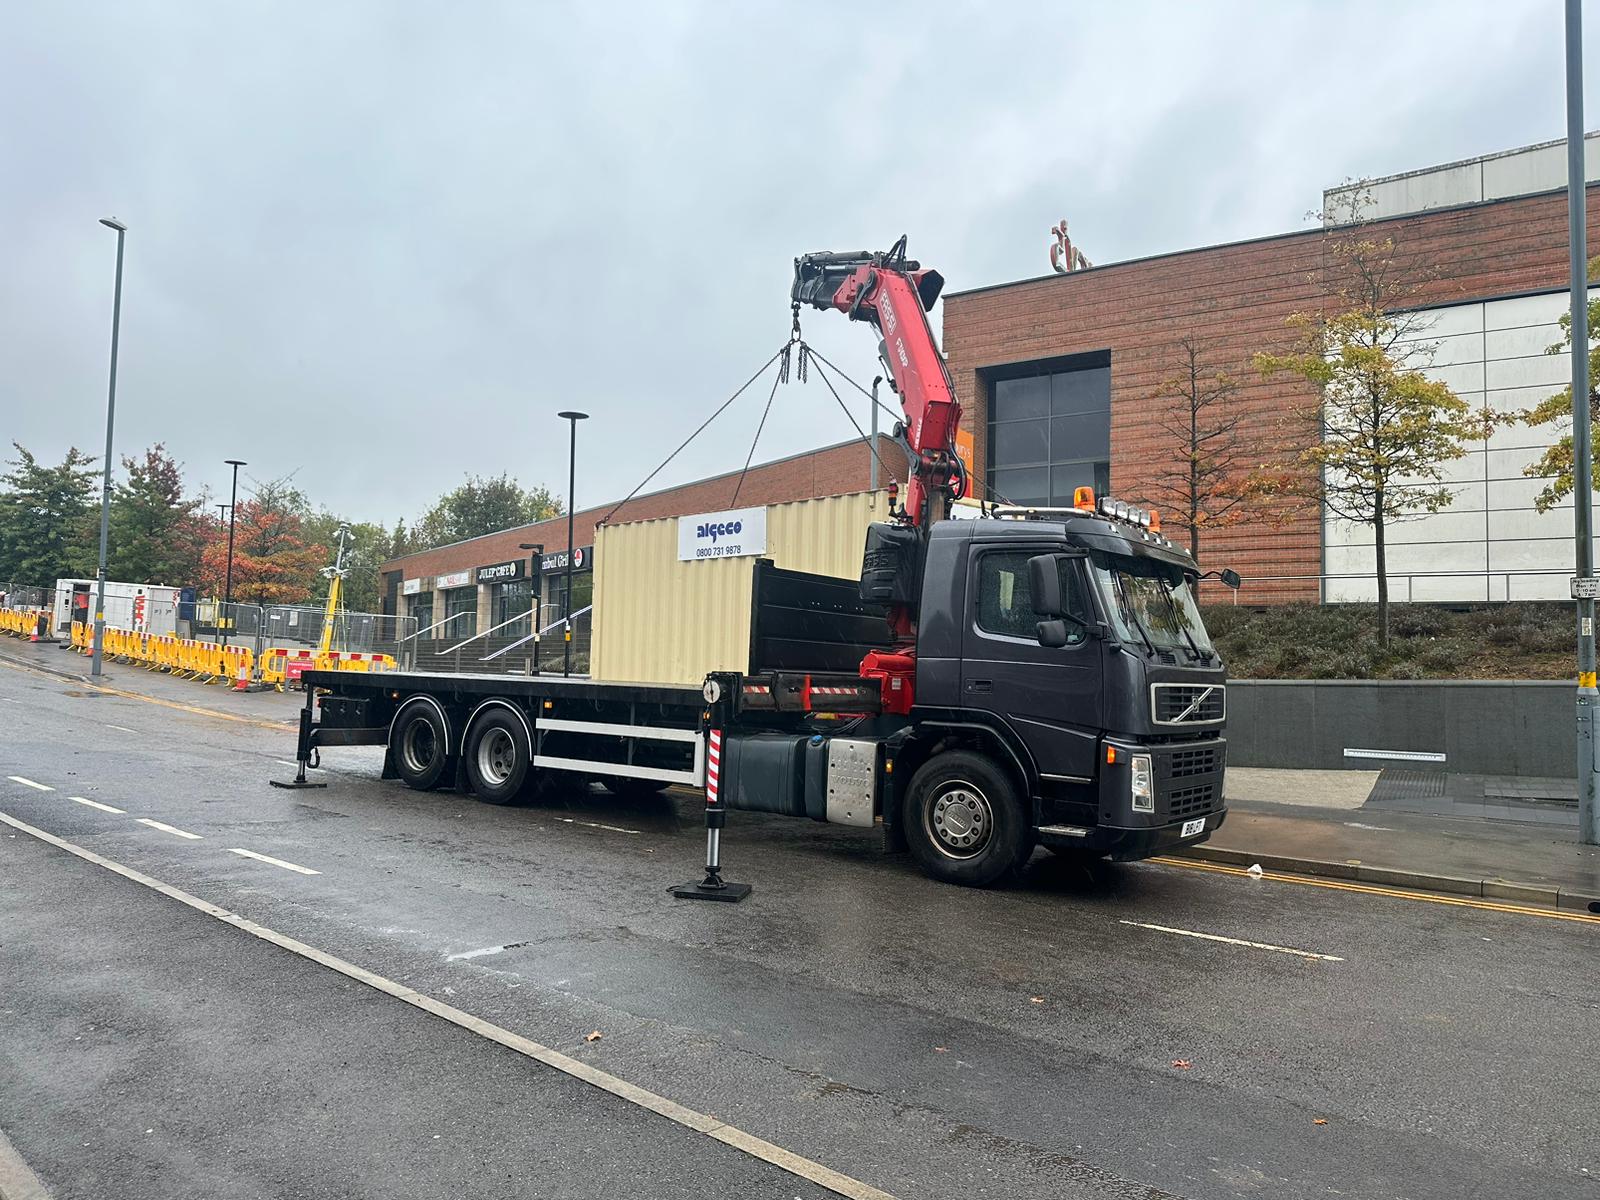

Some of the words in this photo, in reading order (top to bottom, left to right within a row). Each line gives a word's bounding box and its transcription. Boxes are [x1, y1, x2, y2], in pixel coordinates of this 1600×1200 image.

[697, 521, 742, 544] algeco
[696, 548, 711, 558] 0800
[713, 547, 724, 556] 731
[726, 545, 742, 555] 9878
[479, 568, 496, 580] JULEP
[496, 565, 510, 577] CAFE
